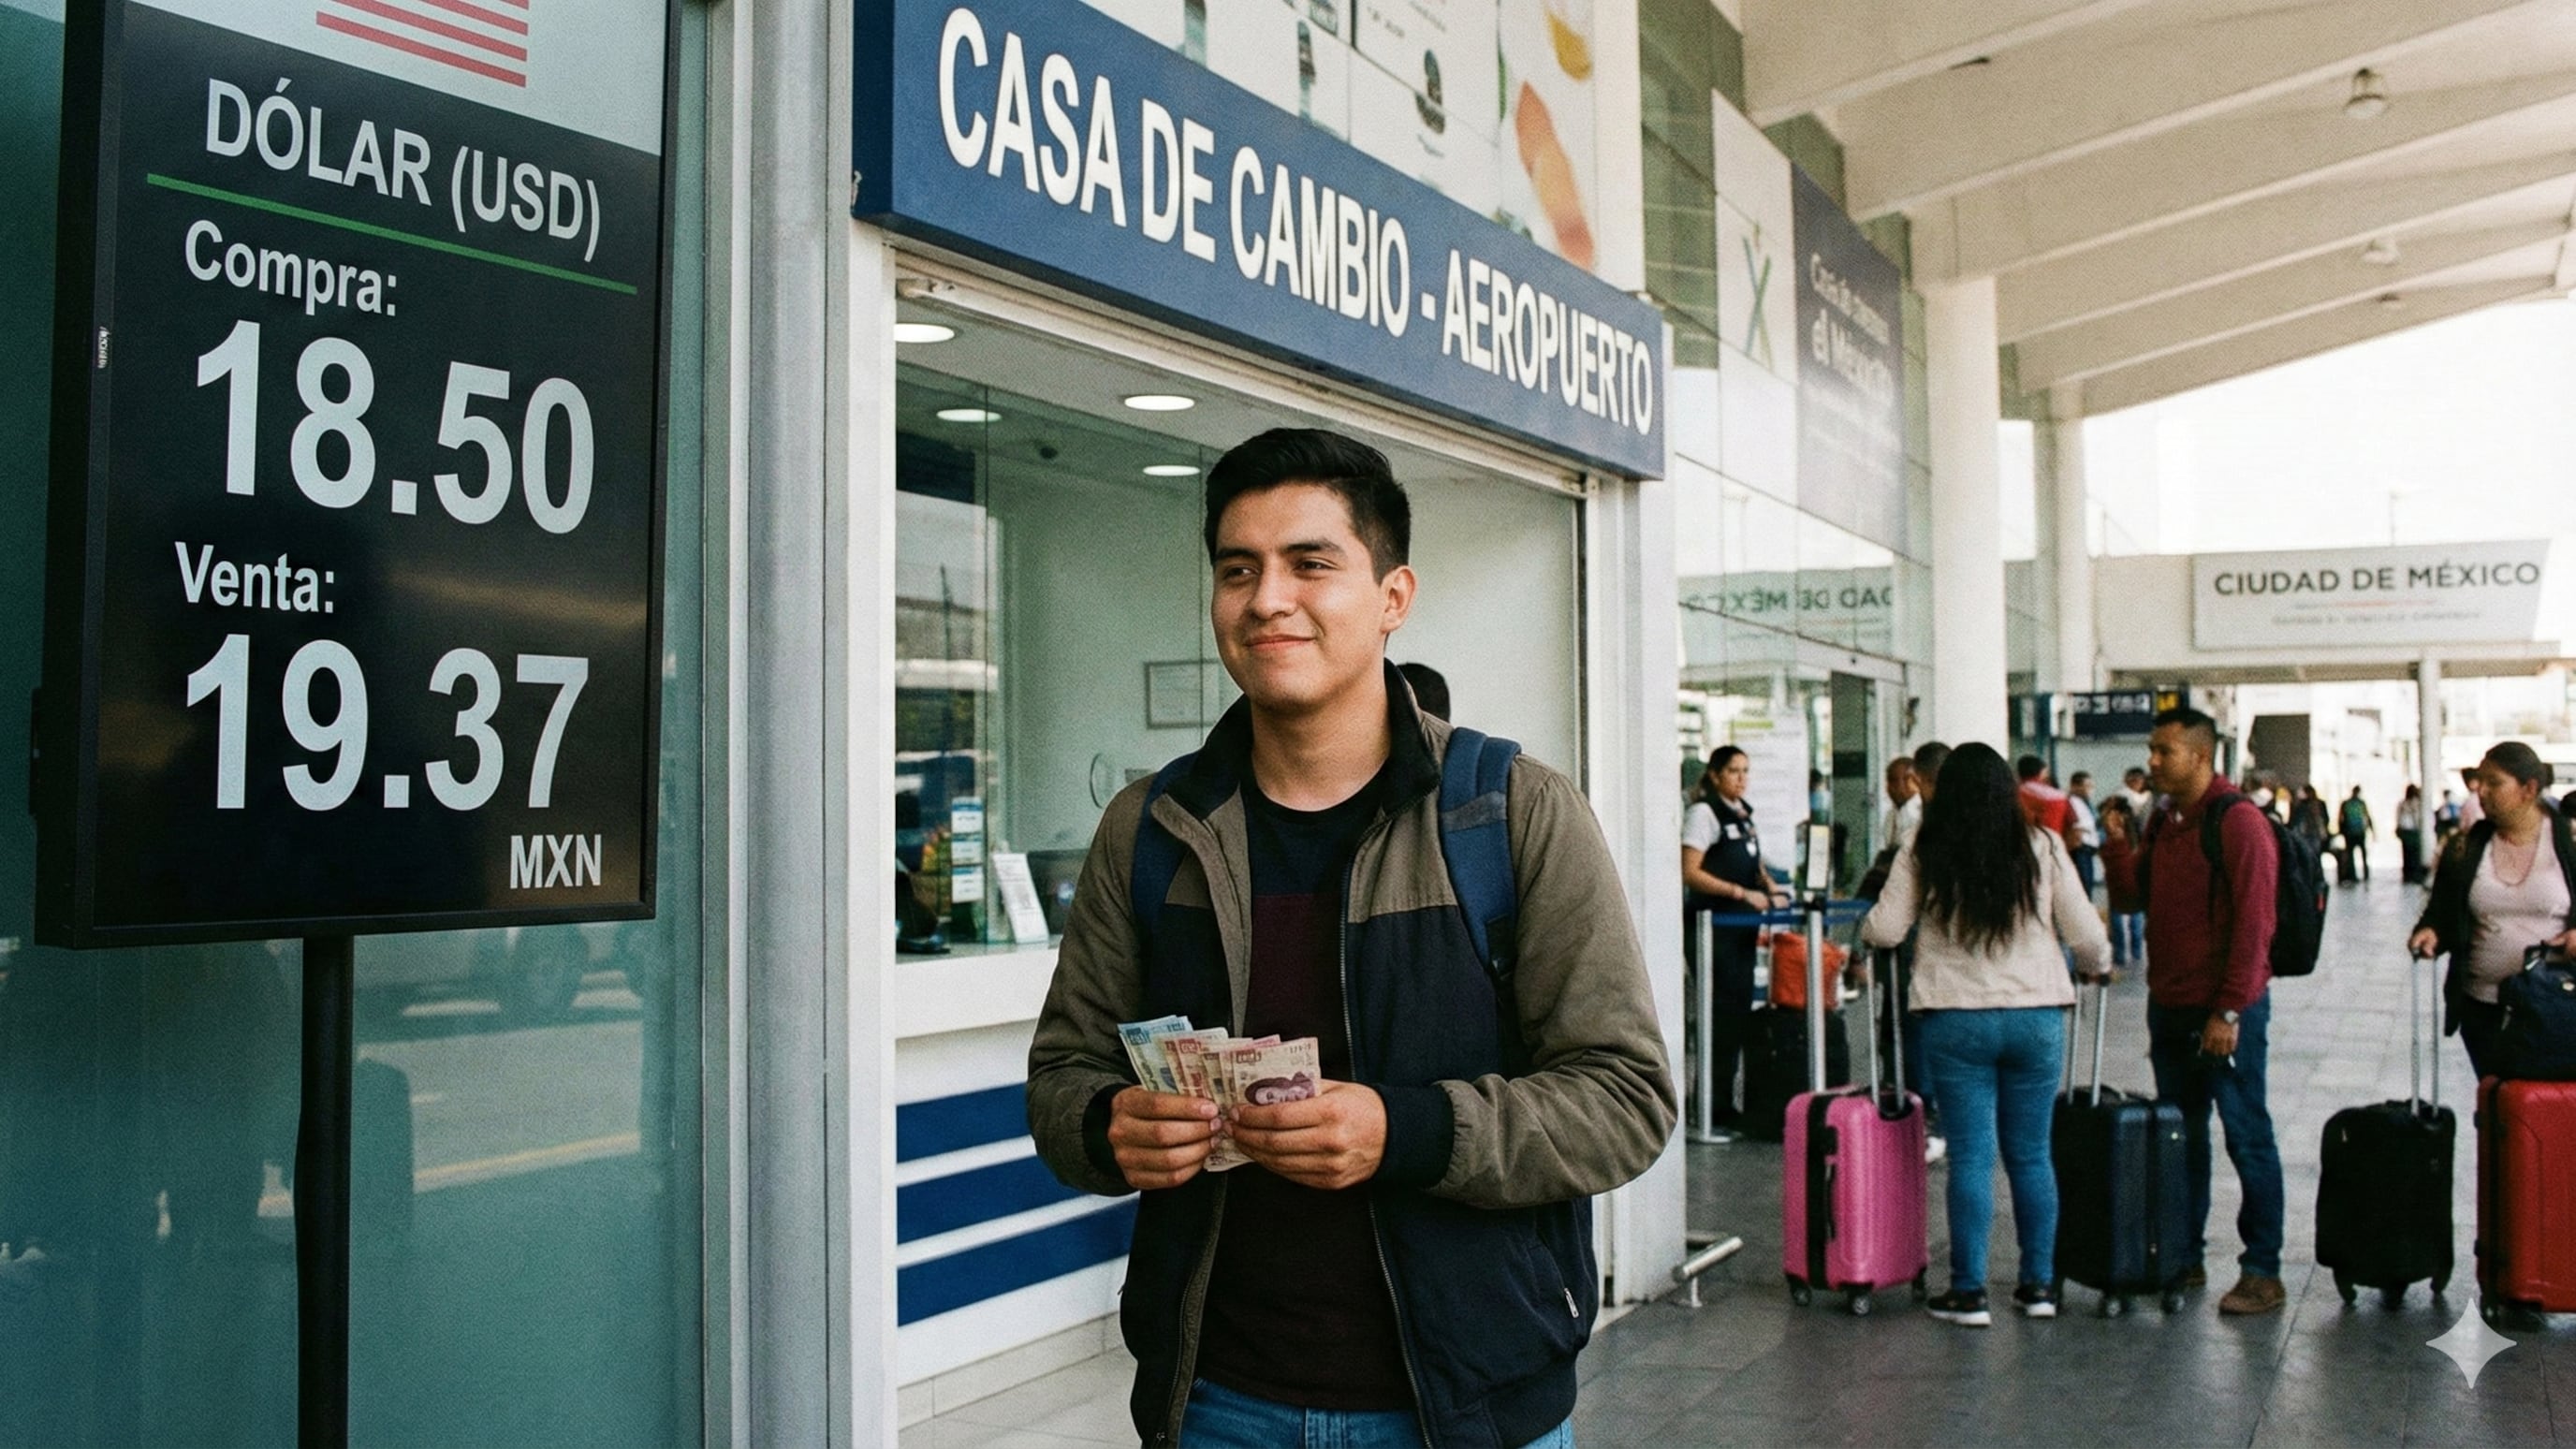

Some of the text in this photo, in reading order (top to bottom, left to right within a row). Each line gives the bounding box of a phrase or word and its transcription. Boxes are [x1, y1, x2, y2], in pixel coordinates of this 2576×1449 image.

[206, 77, 601, 262] DÓLAR (USD)
[940, 8, 1126, 227] CASA
[1142, 99, 1216, 262] DE
[1231, 146, 1411, 337] CAMBIO
[1442, 250, 1653, 436] AEROPUERTO
[185, 219, 397, 316] Compra:
[197, 319, 594, 534] 18.50
[174, 541, 334, 613] Venta:
[2213, 559, 2540, 596] CIUDAD DE MÉXICO
[186, 634, 589, 812] 19.37
[509, 834, 602, 889] MXN
